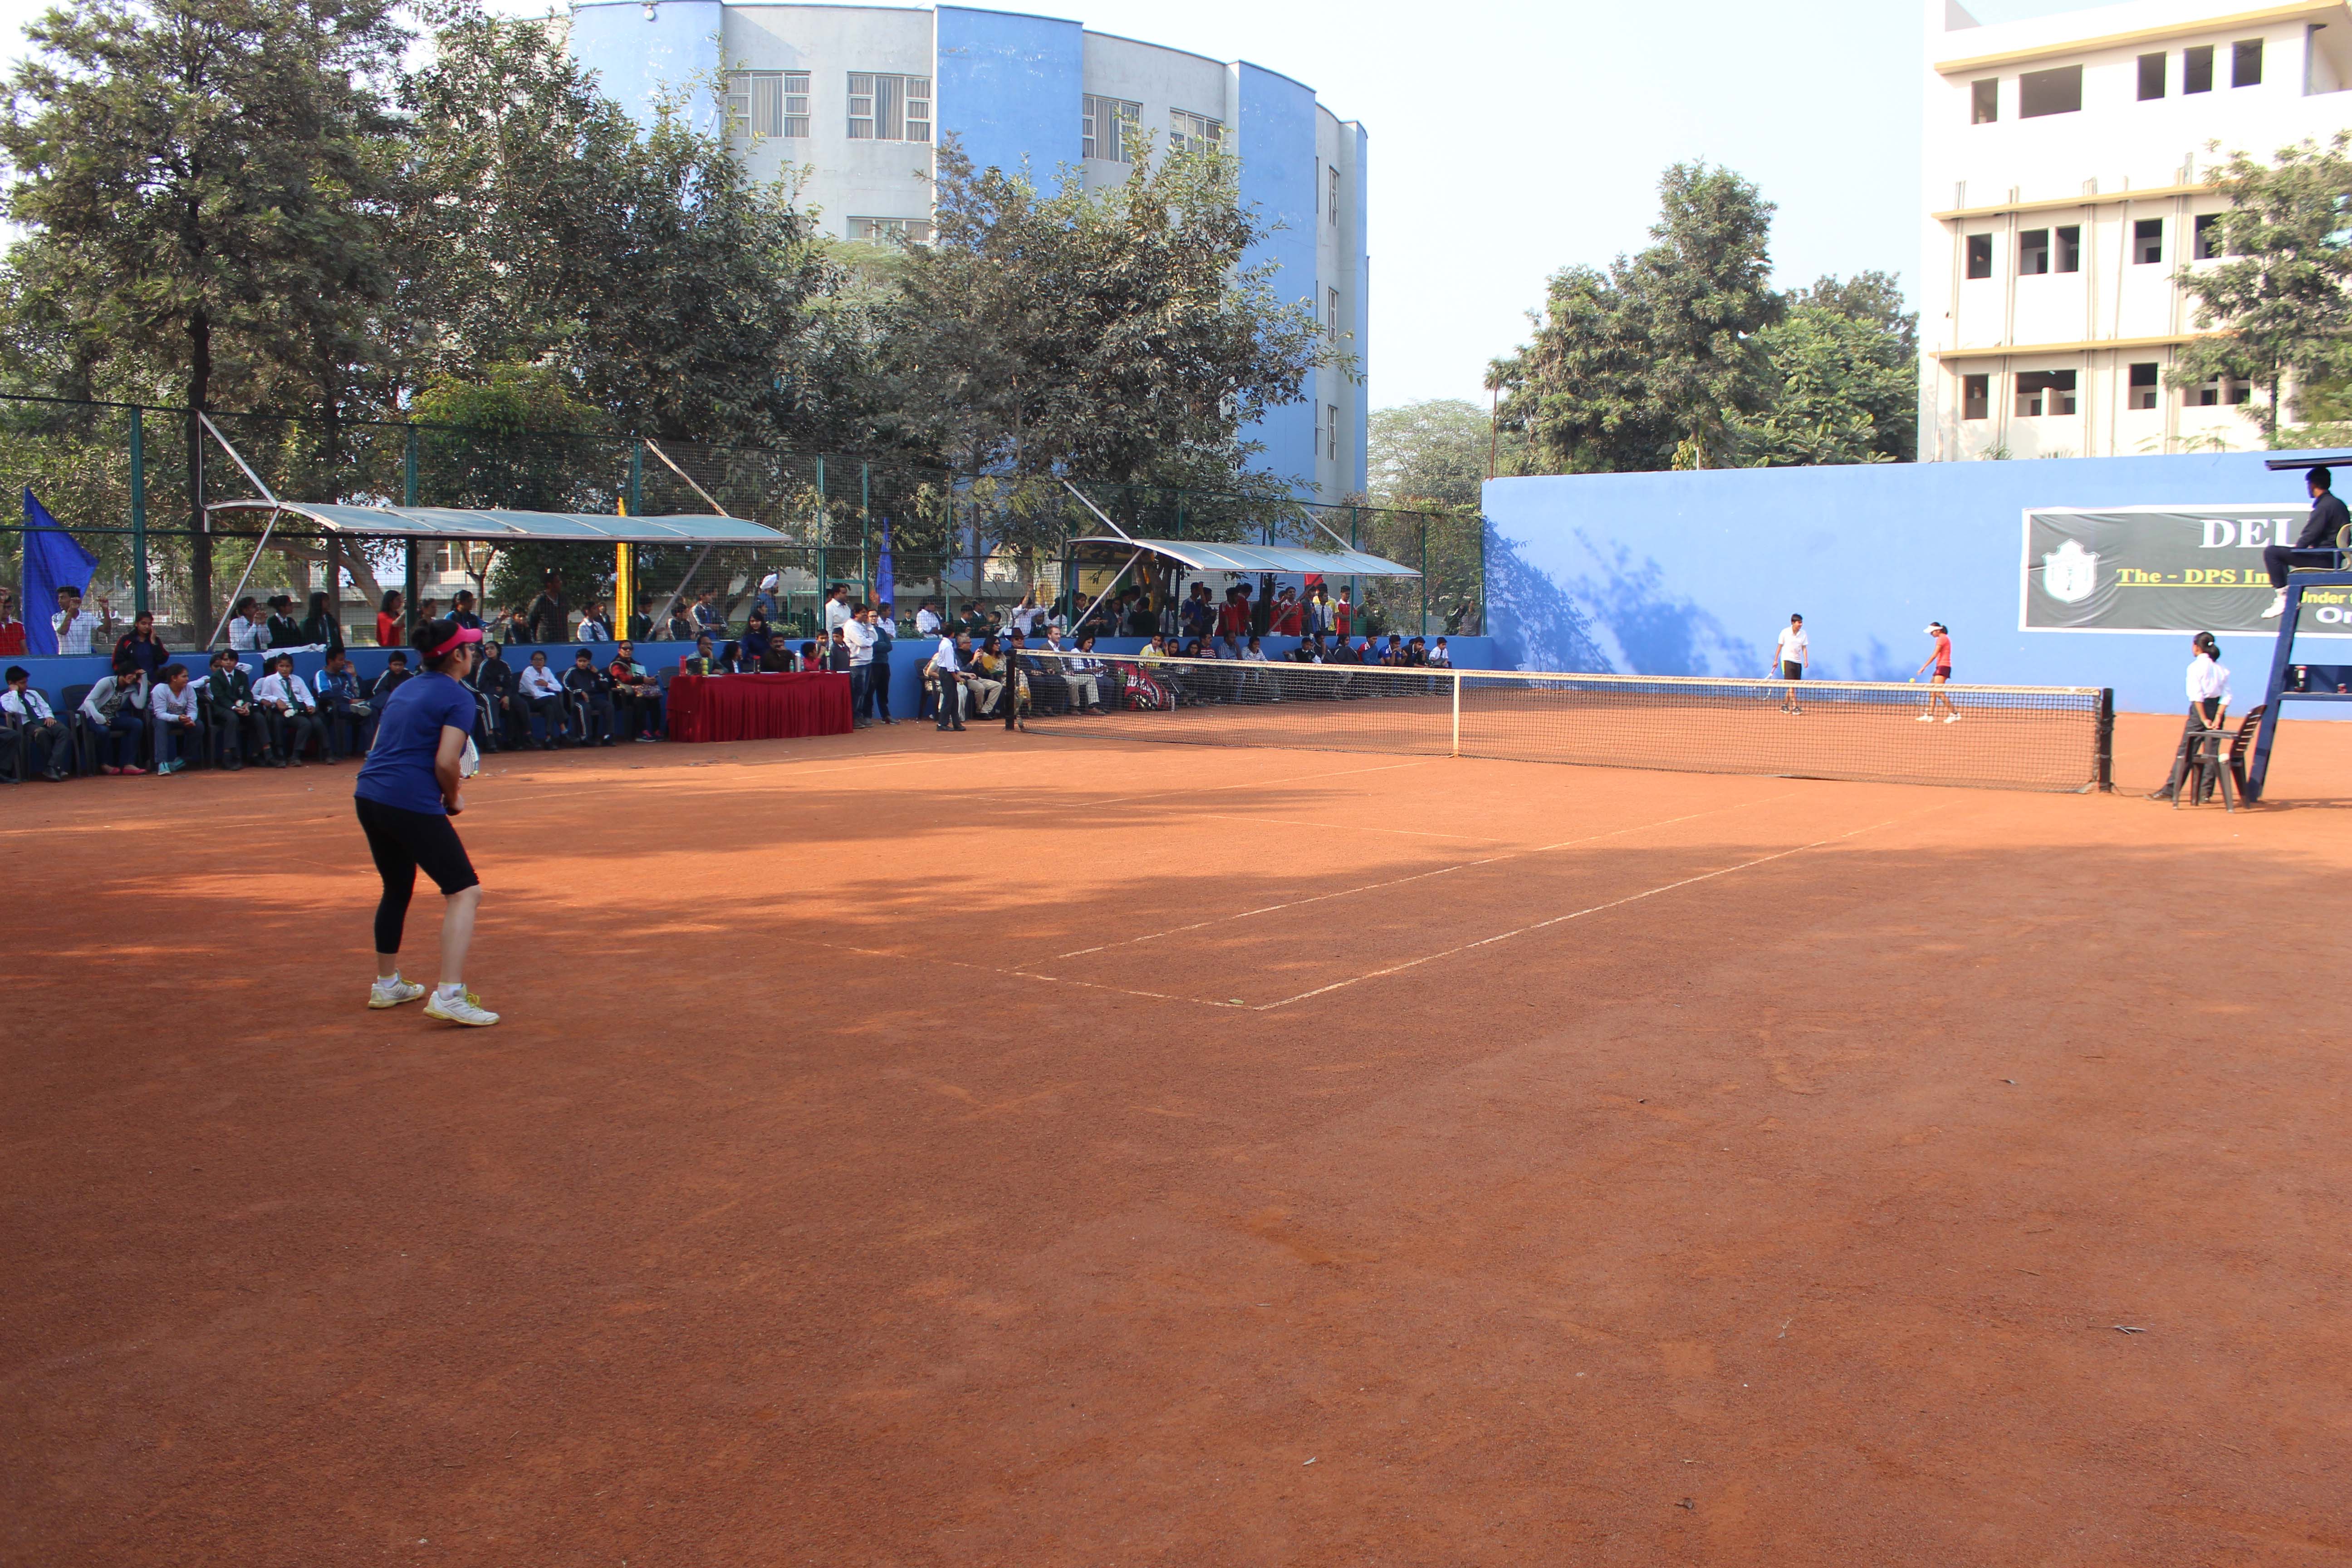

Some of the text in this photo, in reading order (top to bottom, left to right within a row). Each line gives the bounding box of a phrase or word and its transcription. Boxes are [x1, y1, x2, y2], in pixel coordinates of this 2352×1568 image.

[2198, 518, 2297, 548] DEL
[2116, 568, 2162, 583] The
[2183, 568, 2237, 584] DPS
